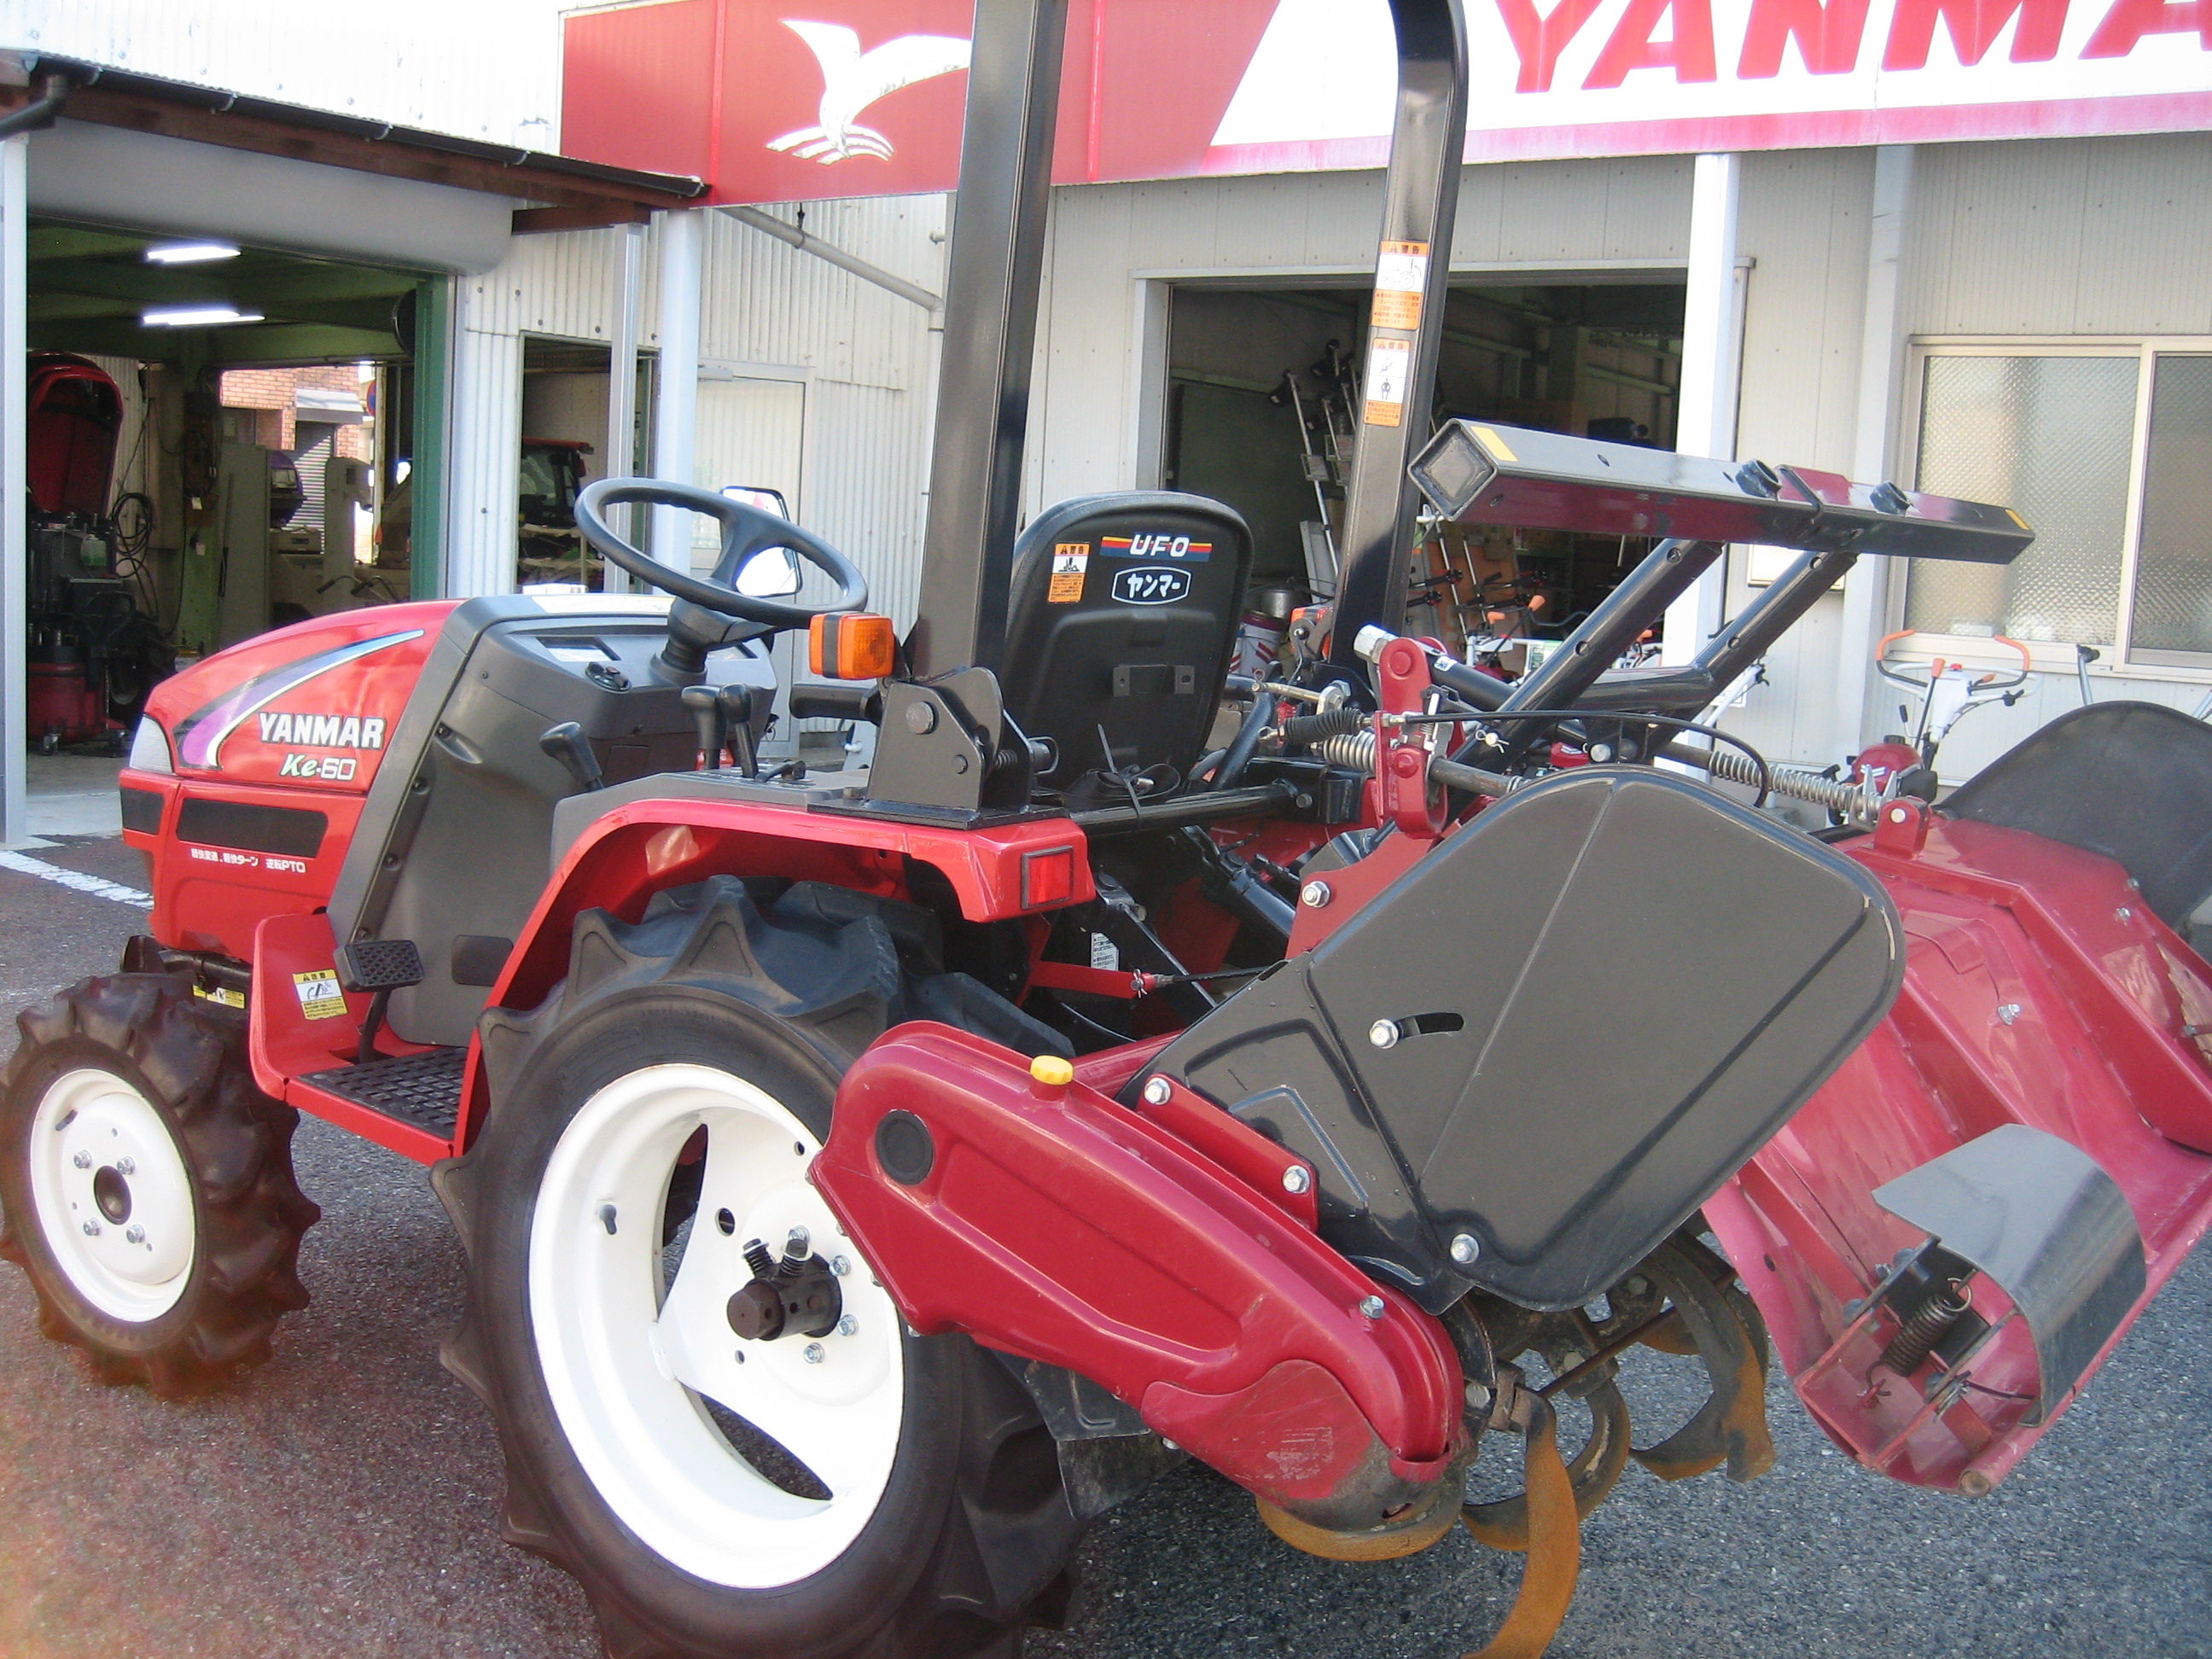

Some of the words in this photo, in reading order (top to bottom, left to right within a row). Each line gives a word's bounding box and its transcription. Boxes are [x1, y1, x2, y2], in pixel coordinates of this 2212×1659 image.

[1129, 533, 1190, 557] UFO
[1126, 573, 1181, 598] ヤンマー
[259, 713, 386, 748] YANMAR
